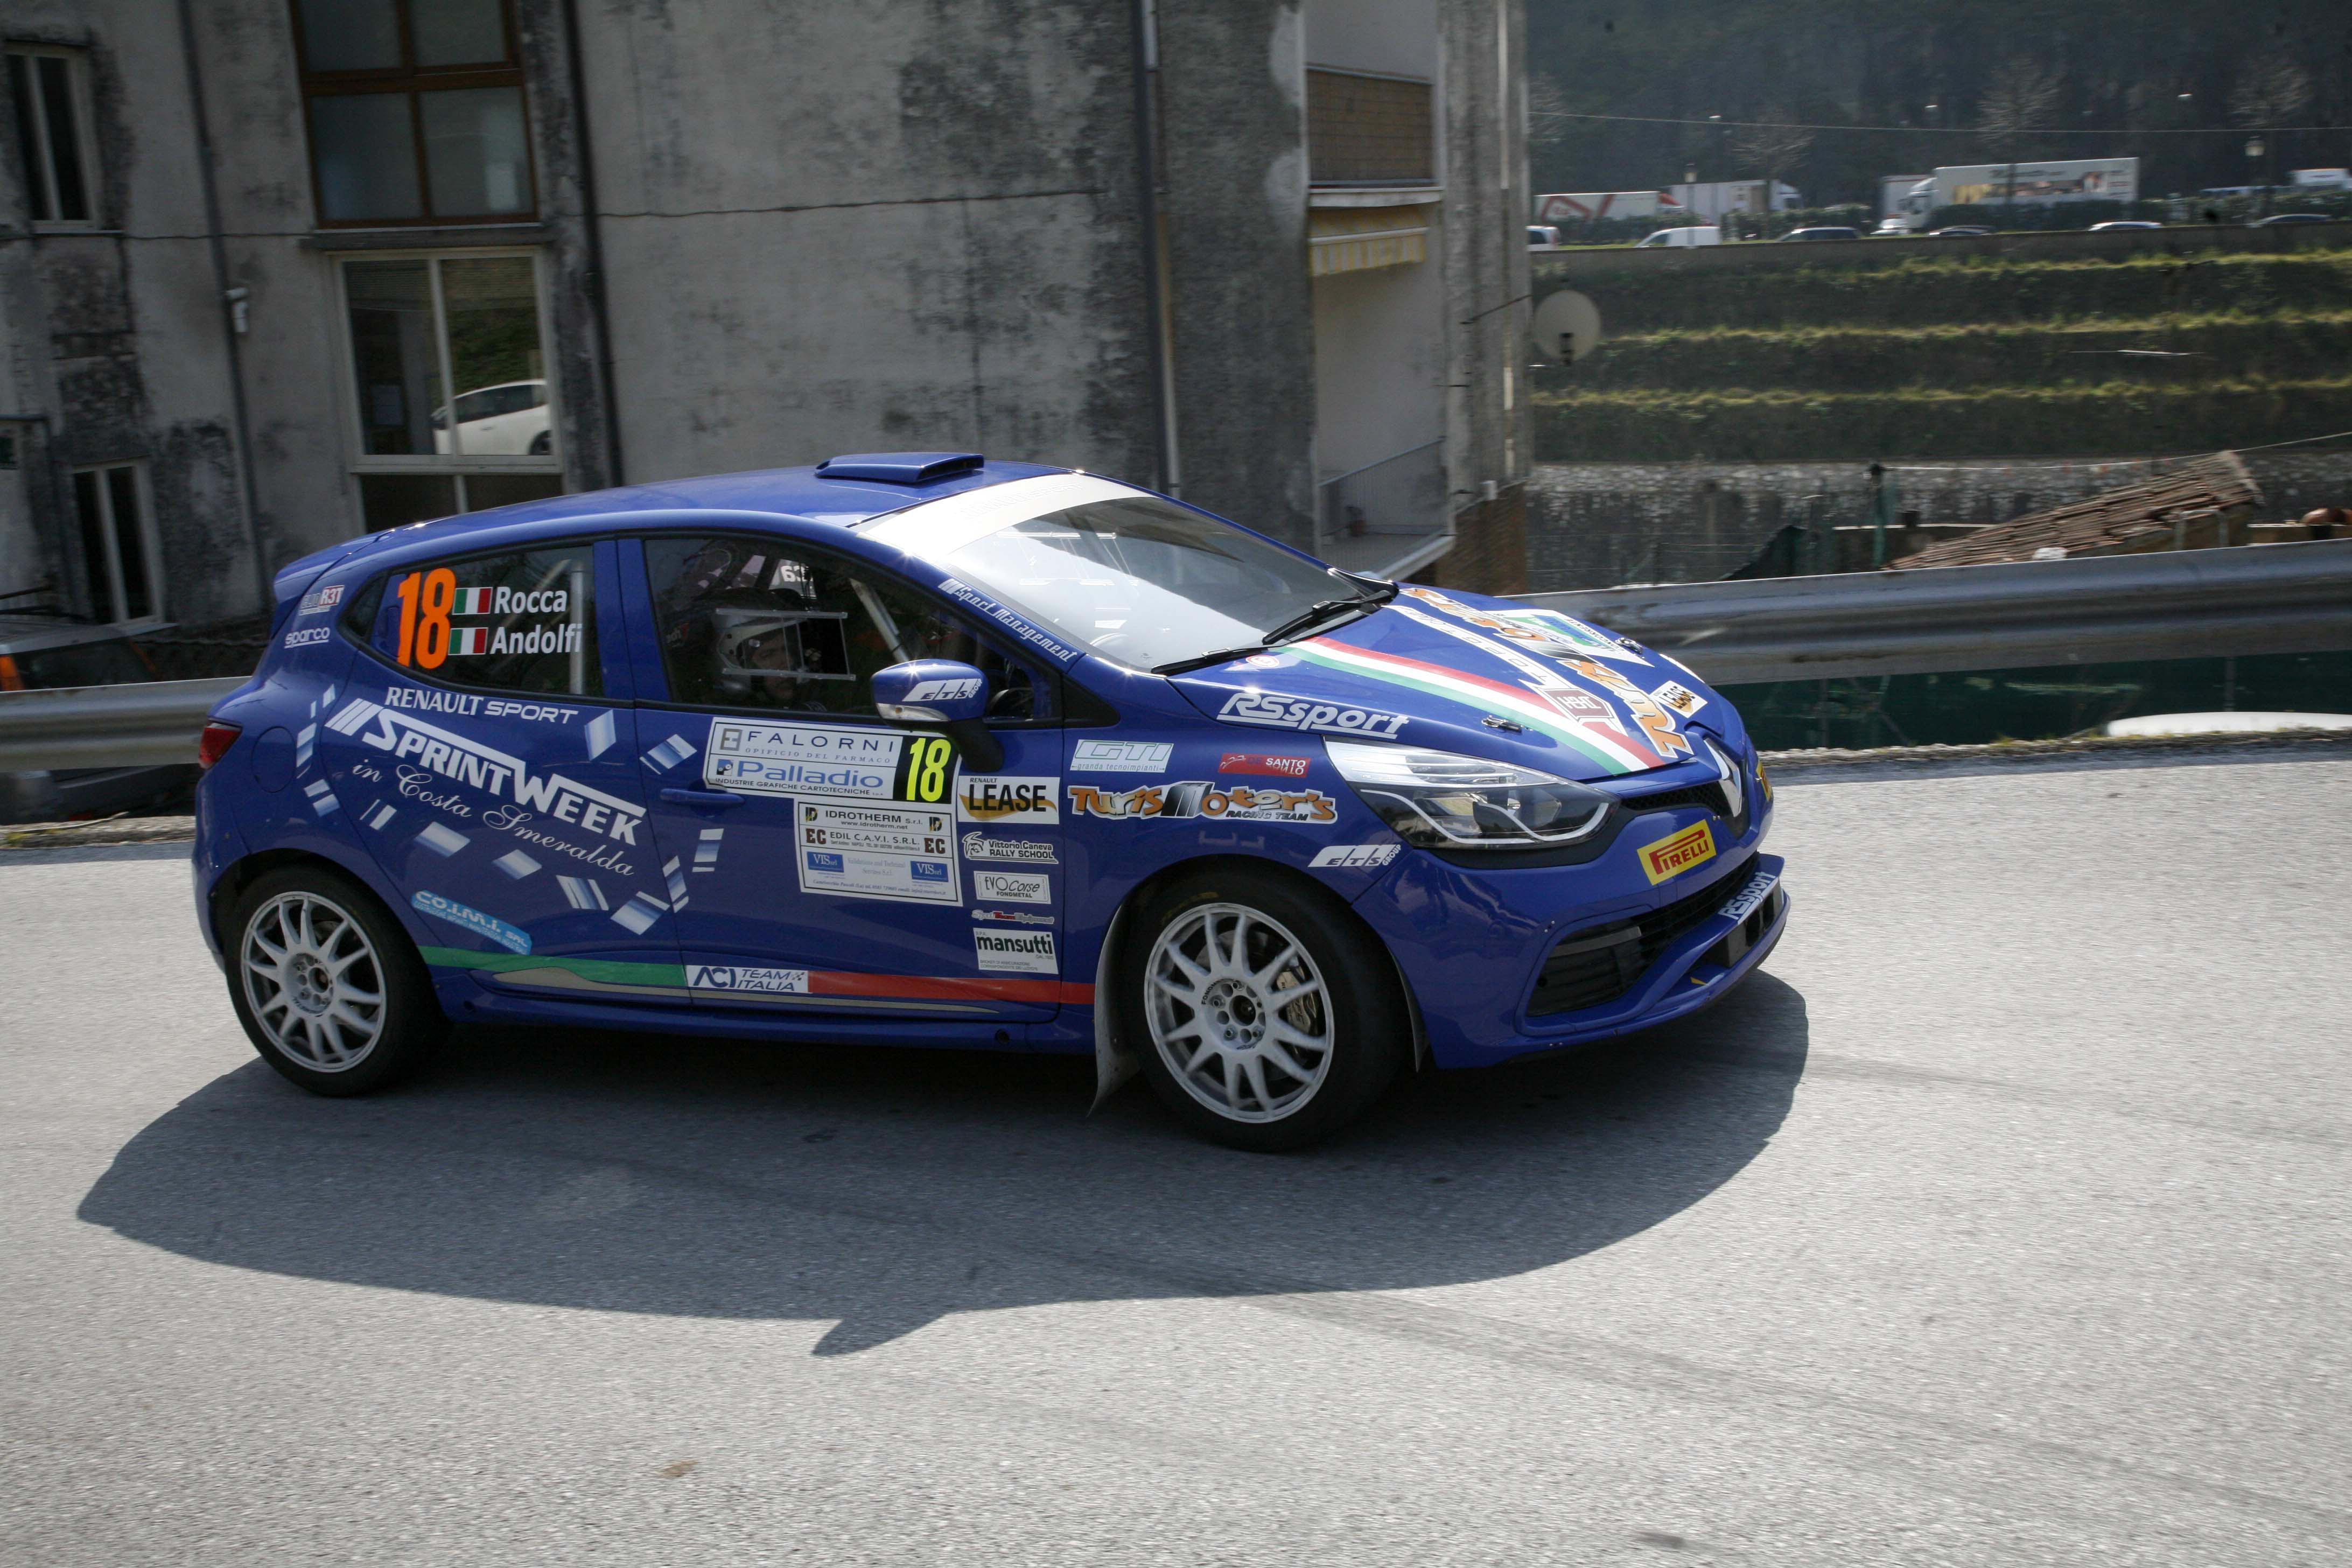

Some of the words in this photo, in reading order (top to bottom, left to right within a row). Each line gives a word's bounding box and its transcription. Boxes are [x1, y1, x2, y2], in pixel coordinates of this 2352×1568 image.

[494, 586, 567, 614] Rocca
[397, 568, 457, 669] 18
[954, 585, 996, 617] Sport
[995, 608, 1077, 662] Management
[284, 627, 331, 648] sparco
[491, 624, 583, 655] Andolfi
[968, 678, 983, 698] GROUP
[1659, 685, 1696, 709] LEASE
[384, 687, 484, 716] RENAULT
[485, 701, 578, 725] SPORT
[747, 731, 894, 752] FALORNI
[1074, 740, 1173, 761] GTI
[745, 747, 800, 757] OPIFICIO
[835, 754, 891, 764] FARMACO
[1265, 758, 1306, 768] SANTO
[737, 760, 884, 788] Palladio
[906, 737, 951, 802] 18
[1077, 762, 1103, 771] granda
[1106, 764, 1158, 772] tecnoimpianti
[715, 778, 754, 786] INDUSTRIE
[757, 781, 797, 790] GRAFICHE
[800, 785, 870, 795] CARTOTECNICHE
[969, 783, 1047, 812] LEASE
[352, 759, 382, 783] in
[396, 764, 472, 818] Costa
[483, 804, 635, 877] Smeralda
[825, 810, 901, 823] IDROTHERM
[841, 820, 908, 830] www.idrotherm.net
[1226, 810, 1272, 820] RACING
[1275, 811, 1308, 821] TEAM
[806, 828, 827, 845] EC
[830, 831, 851, 841] EDIL
[854, 834, 890, 843] C.A.V.I.
[892, 836, 920, 845] S.R.L.
[924, 837, 946, 854] EC
[989, 839, 1020, 849] Vittorio
[1023, 842, 1052, 850] Caneva
[813, 853, 830, 865] VIS
[990, 849, 1016, 857] RALLY
[1018, 851, 1053, 859] SCHOOL
[1326, 857, 1381, 866] ETS
[1382, 844, 1402, 866] GROUP
[1648, 829, 1710, 875] PIRELLI
[916, 863, 934, 875] VIS
[976, 934, 1054, 955] mansutti
[693, 966, 737, 988] ACI
[742, 969, 792, 980] TEAM
[737, 979, 795, 991] ITALIA
